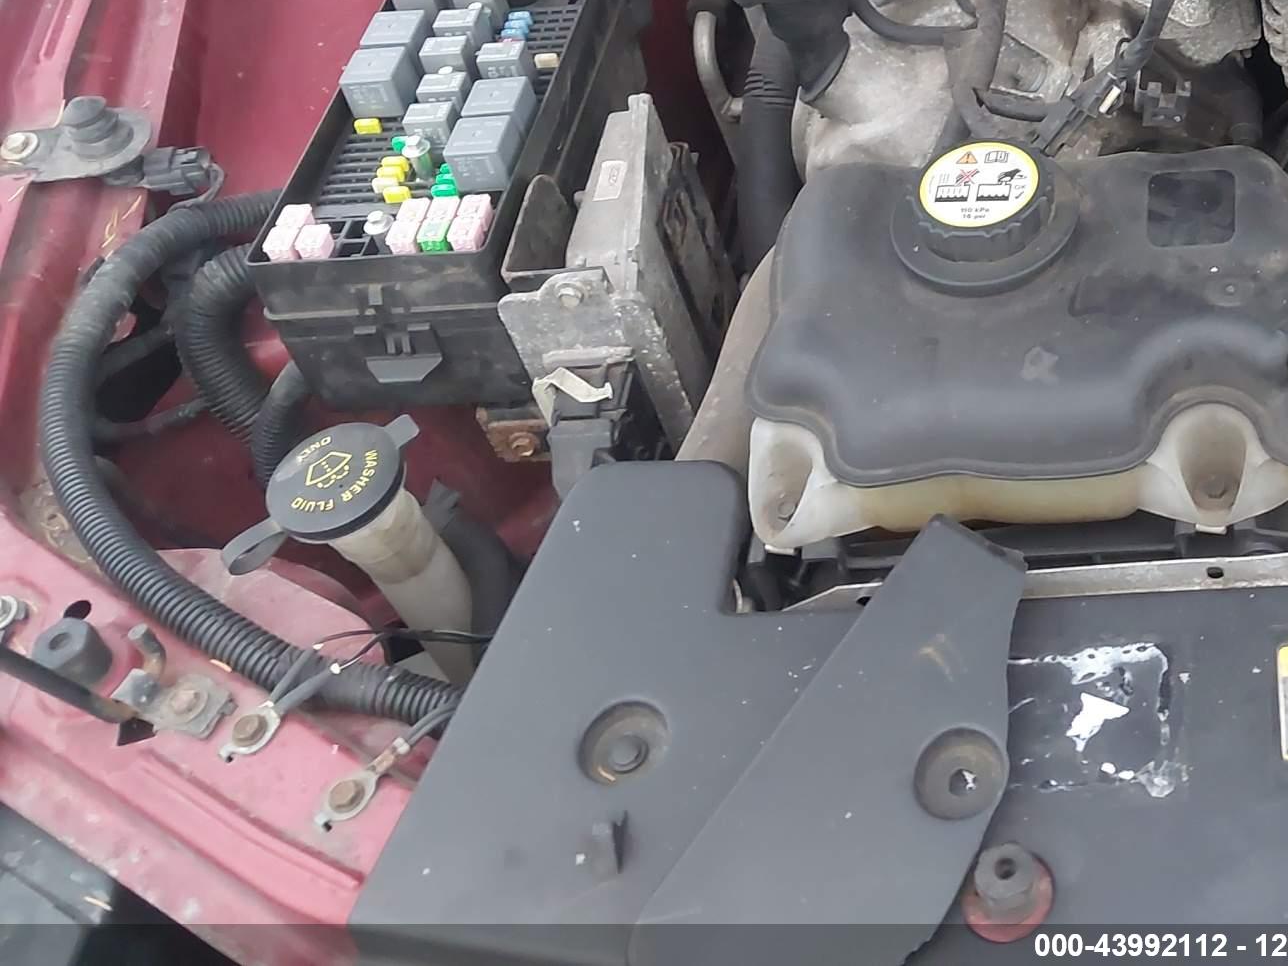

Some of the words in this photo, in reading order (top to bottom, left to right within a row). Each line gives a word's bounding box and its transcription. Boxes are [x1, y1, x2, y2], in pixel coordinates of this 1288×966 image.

[296, 436, 332, 463] ONLY
[340, 449, 379, 502] WASHER
[291, 496, 335, 512] FLUID
